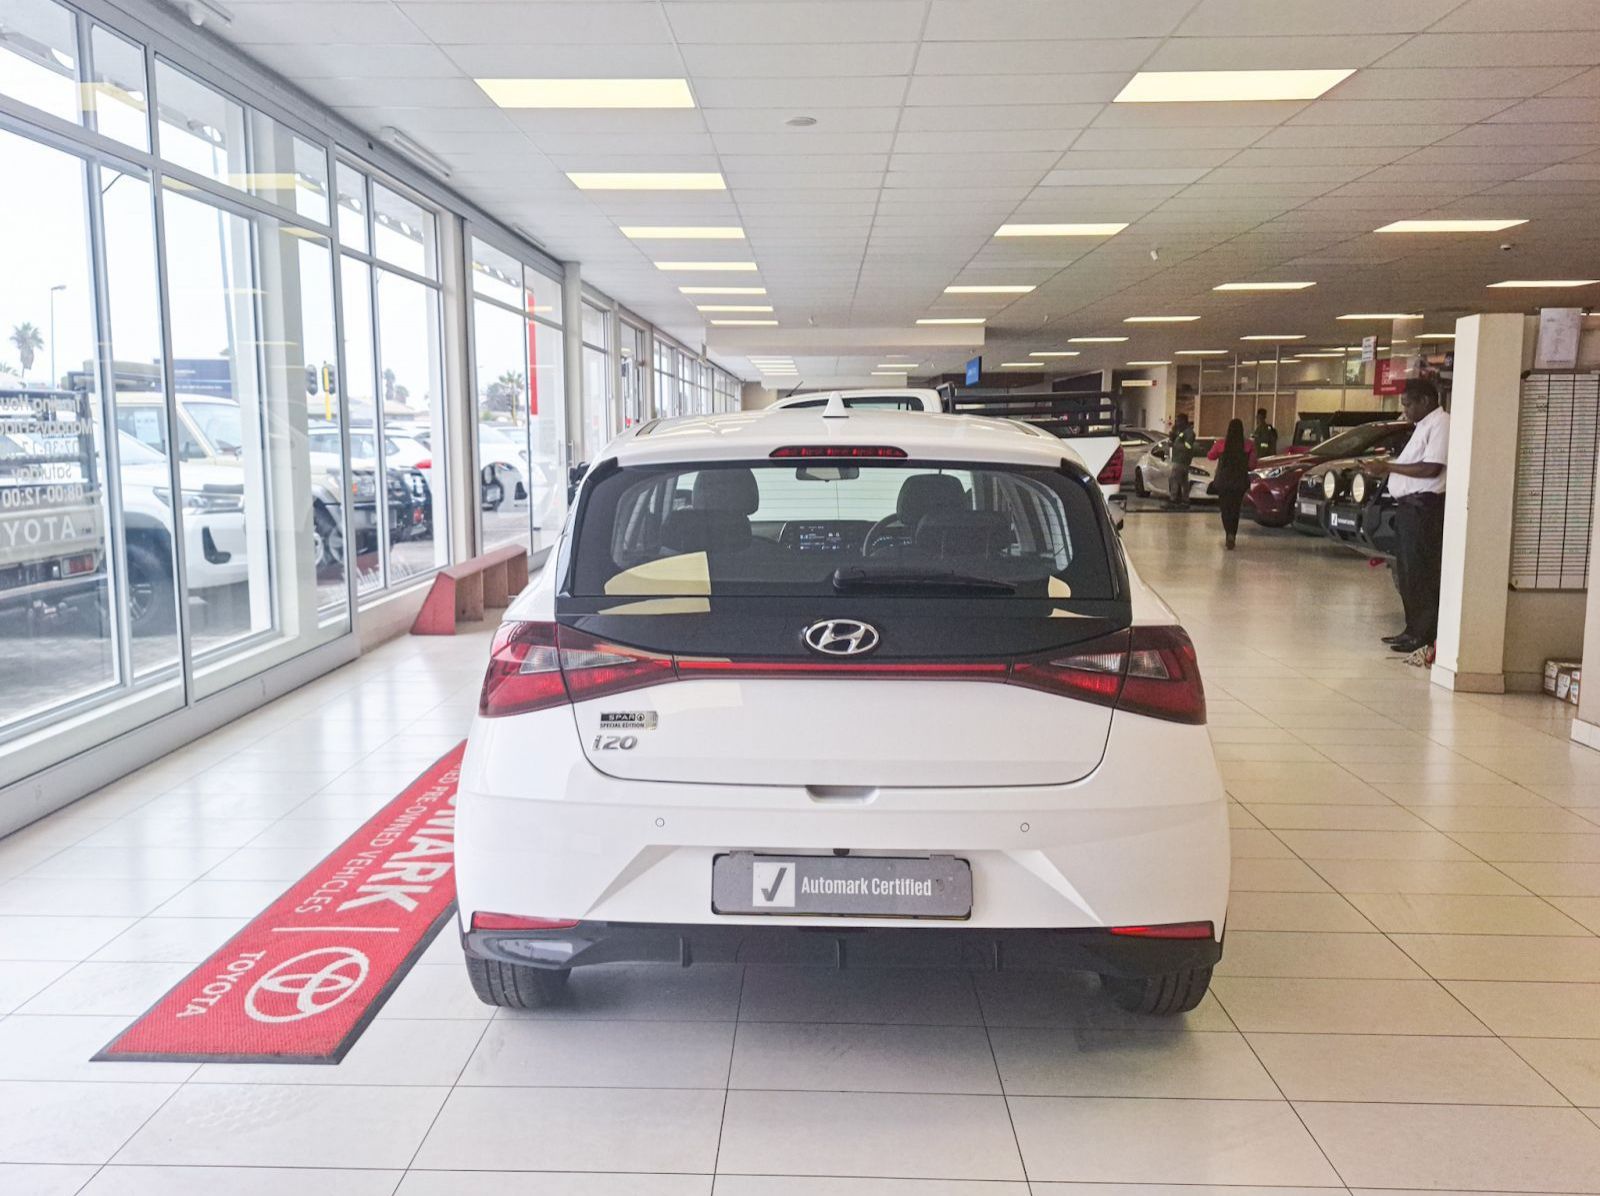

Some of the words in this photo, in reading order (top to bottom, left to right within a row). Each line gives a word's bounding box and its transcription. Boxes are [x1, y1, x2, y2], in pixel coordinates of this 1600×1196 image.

[3, 515, 76, 546] YOTA
[593, 734, 638, 751] i20
[369, 785, 450, 848] PRE-OWNED
[295, 850, 383, 913] VEHICLES
[801, 876, 869, 895] Automark
[871, 878, 932, 896] Certified
[176, 949, 267, 1018] TOYOTA
